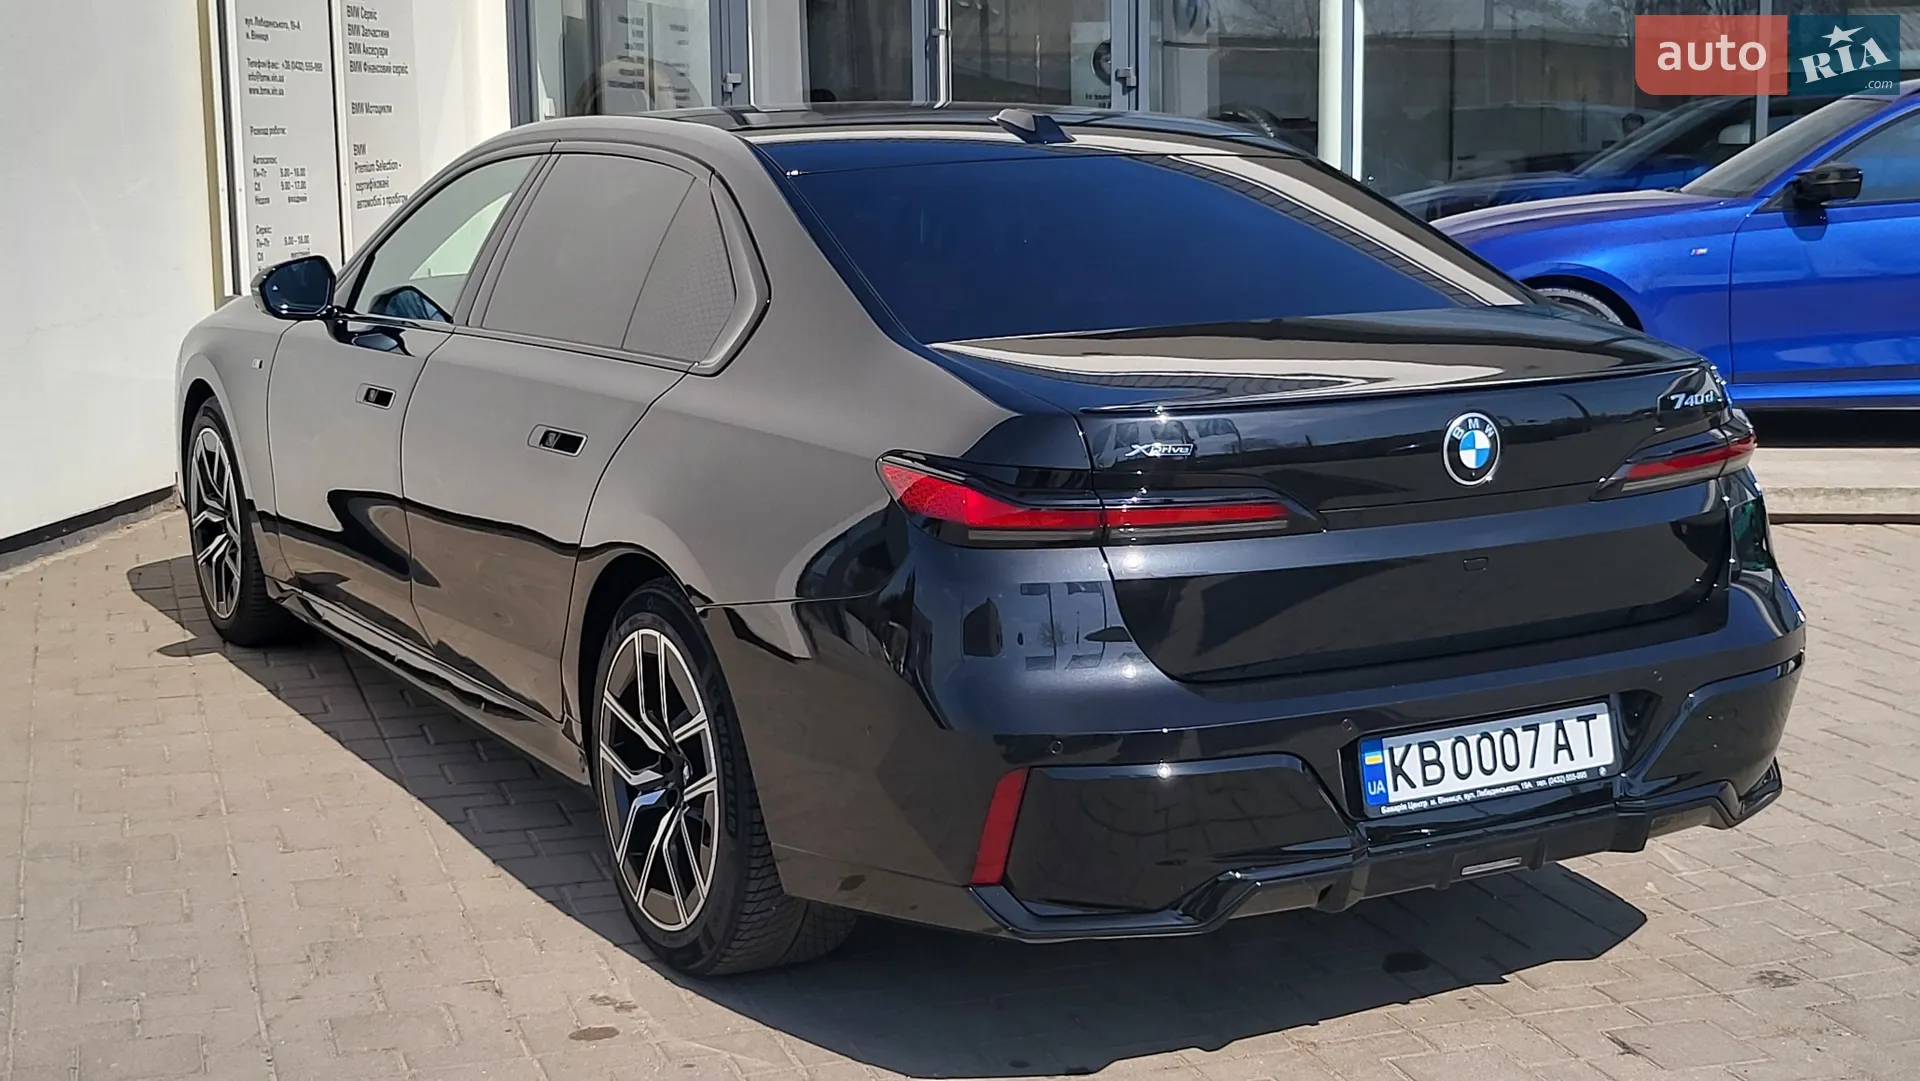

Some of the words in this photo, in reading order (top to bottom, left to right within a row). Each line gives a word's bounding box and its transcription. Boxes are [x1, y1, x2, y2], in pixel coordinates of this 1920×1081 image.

[353, 144, 366, 156] BMW
[354, 160, 375, 174] Premium
[376, 159, 398, 171] Selection
[1670, 390, 1713, 410] 740d
[1367, 778, 1386, 796] UA
